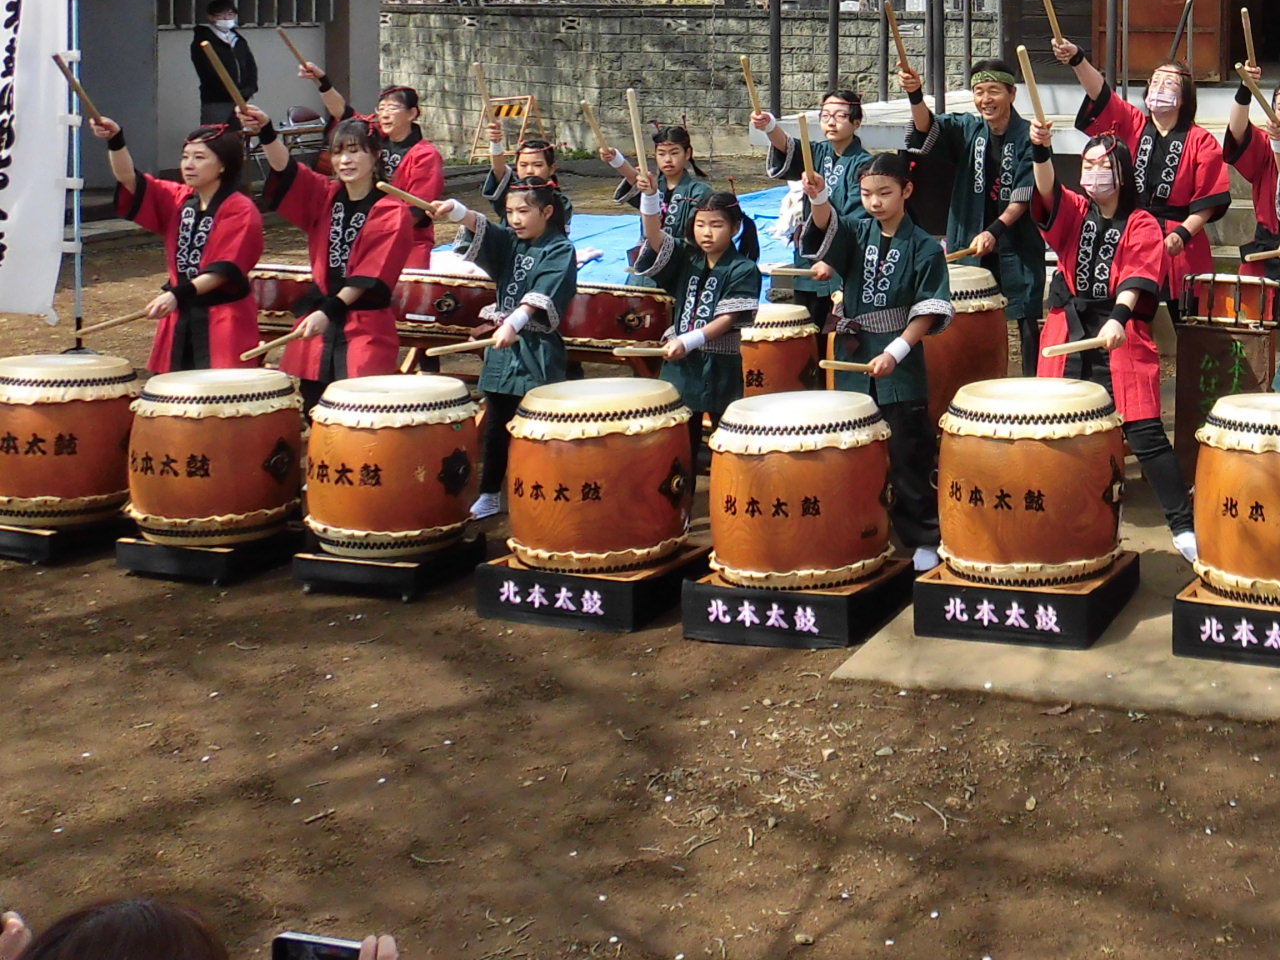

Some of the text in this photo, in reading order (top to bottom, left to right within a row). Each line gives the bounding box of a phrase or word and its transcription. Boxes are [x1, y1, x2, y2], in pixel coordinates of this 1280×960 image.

[514, 478, 601, 502] 北本太鼓
[724, 494, 822, 517] 北本太鼓
[949, 480, 1046, 512] 北本太鼓
[499, 580, 605, 616] 北本太鼓
[944, 597, 1062, 633] 北本太鼓
[707, 598, 820, 635] 北本太鼓
